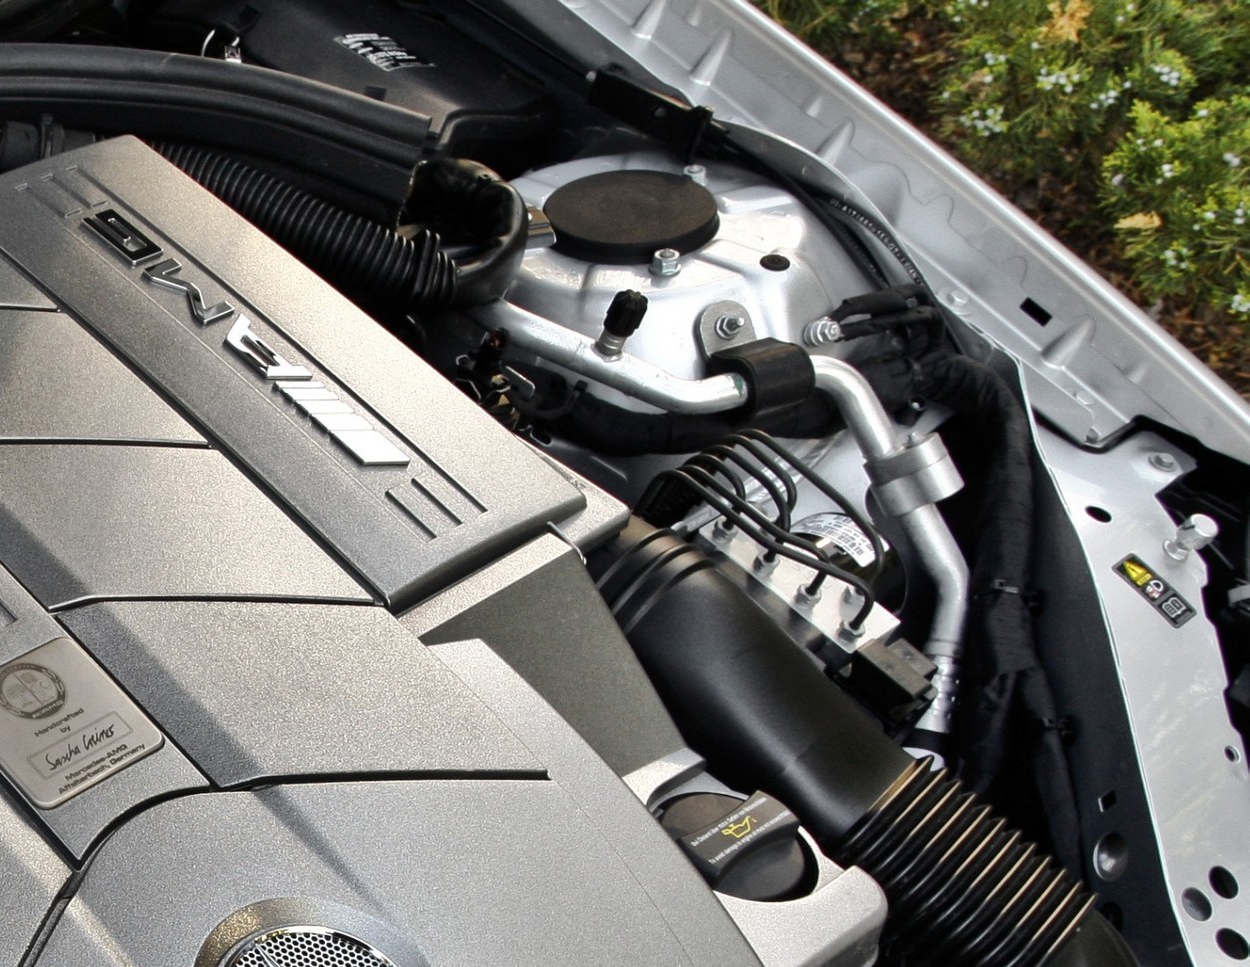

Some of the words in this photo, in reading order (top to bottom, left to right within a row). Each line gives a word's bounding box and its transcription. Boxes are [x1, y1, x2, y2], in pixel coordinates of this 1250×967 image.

[80, 208, 314, 381] AMG
[35, 708, 84, 736] Handcrafted
[65, 744, 127, 780] Mercedes-AMG
[110, 744, 145, 765] Germany
